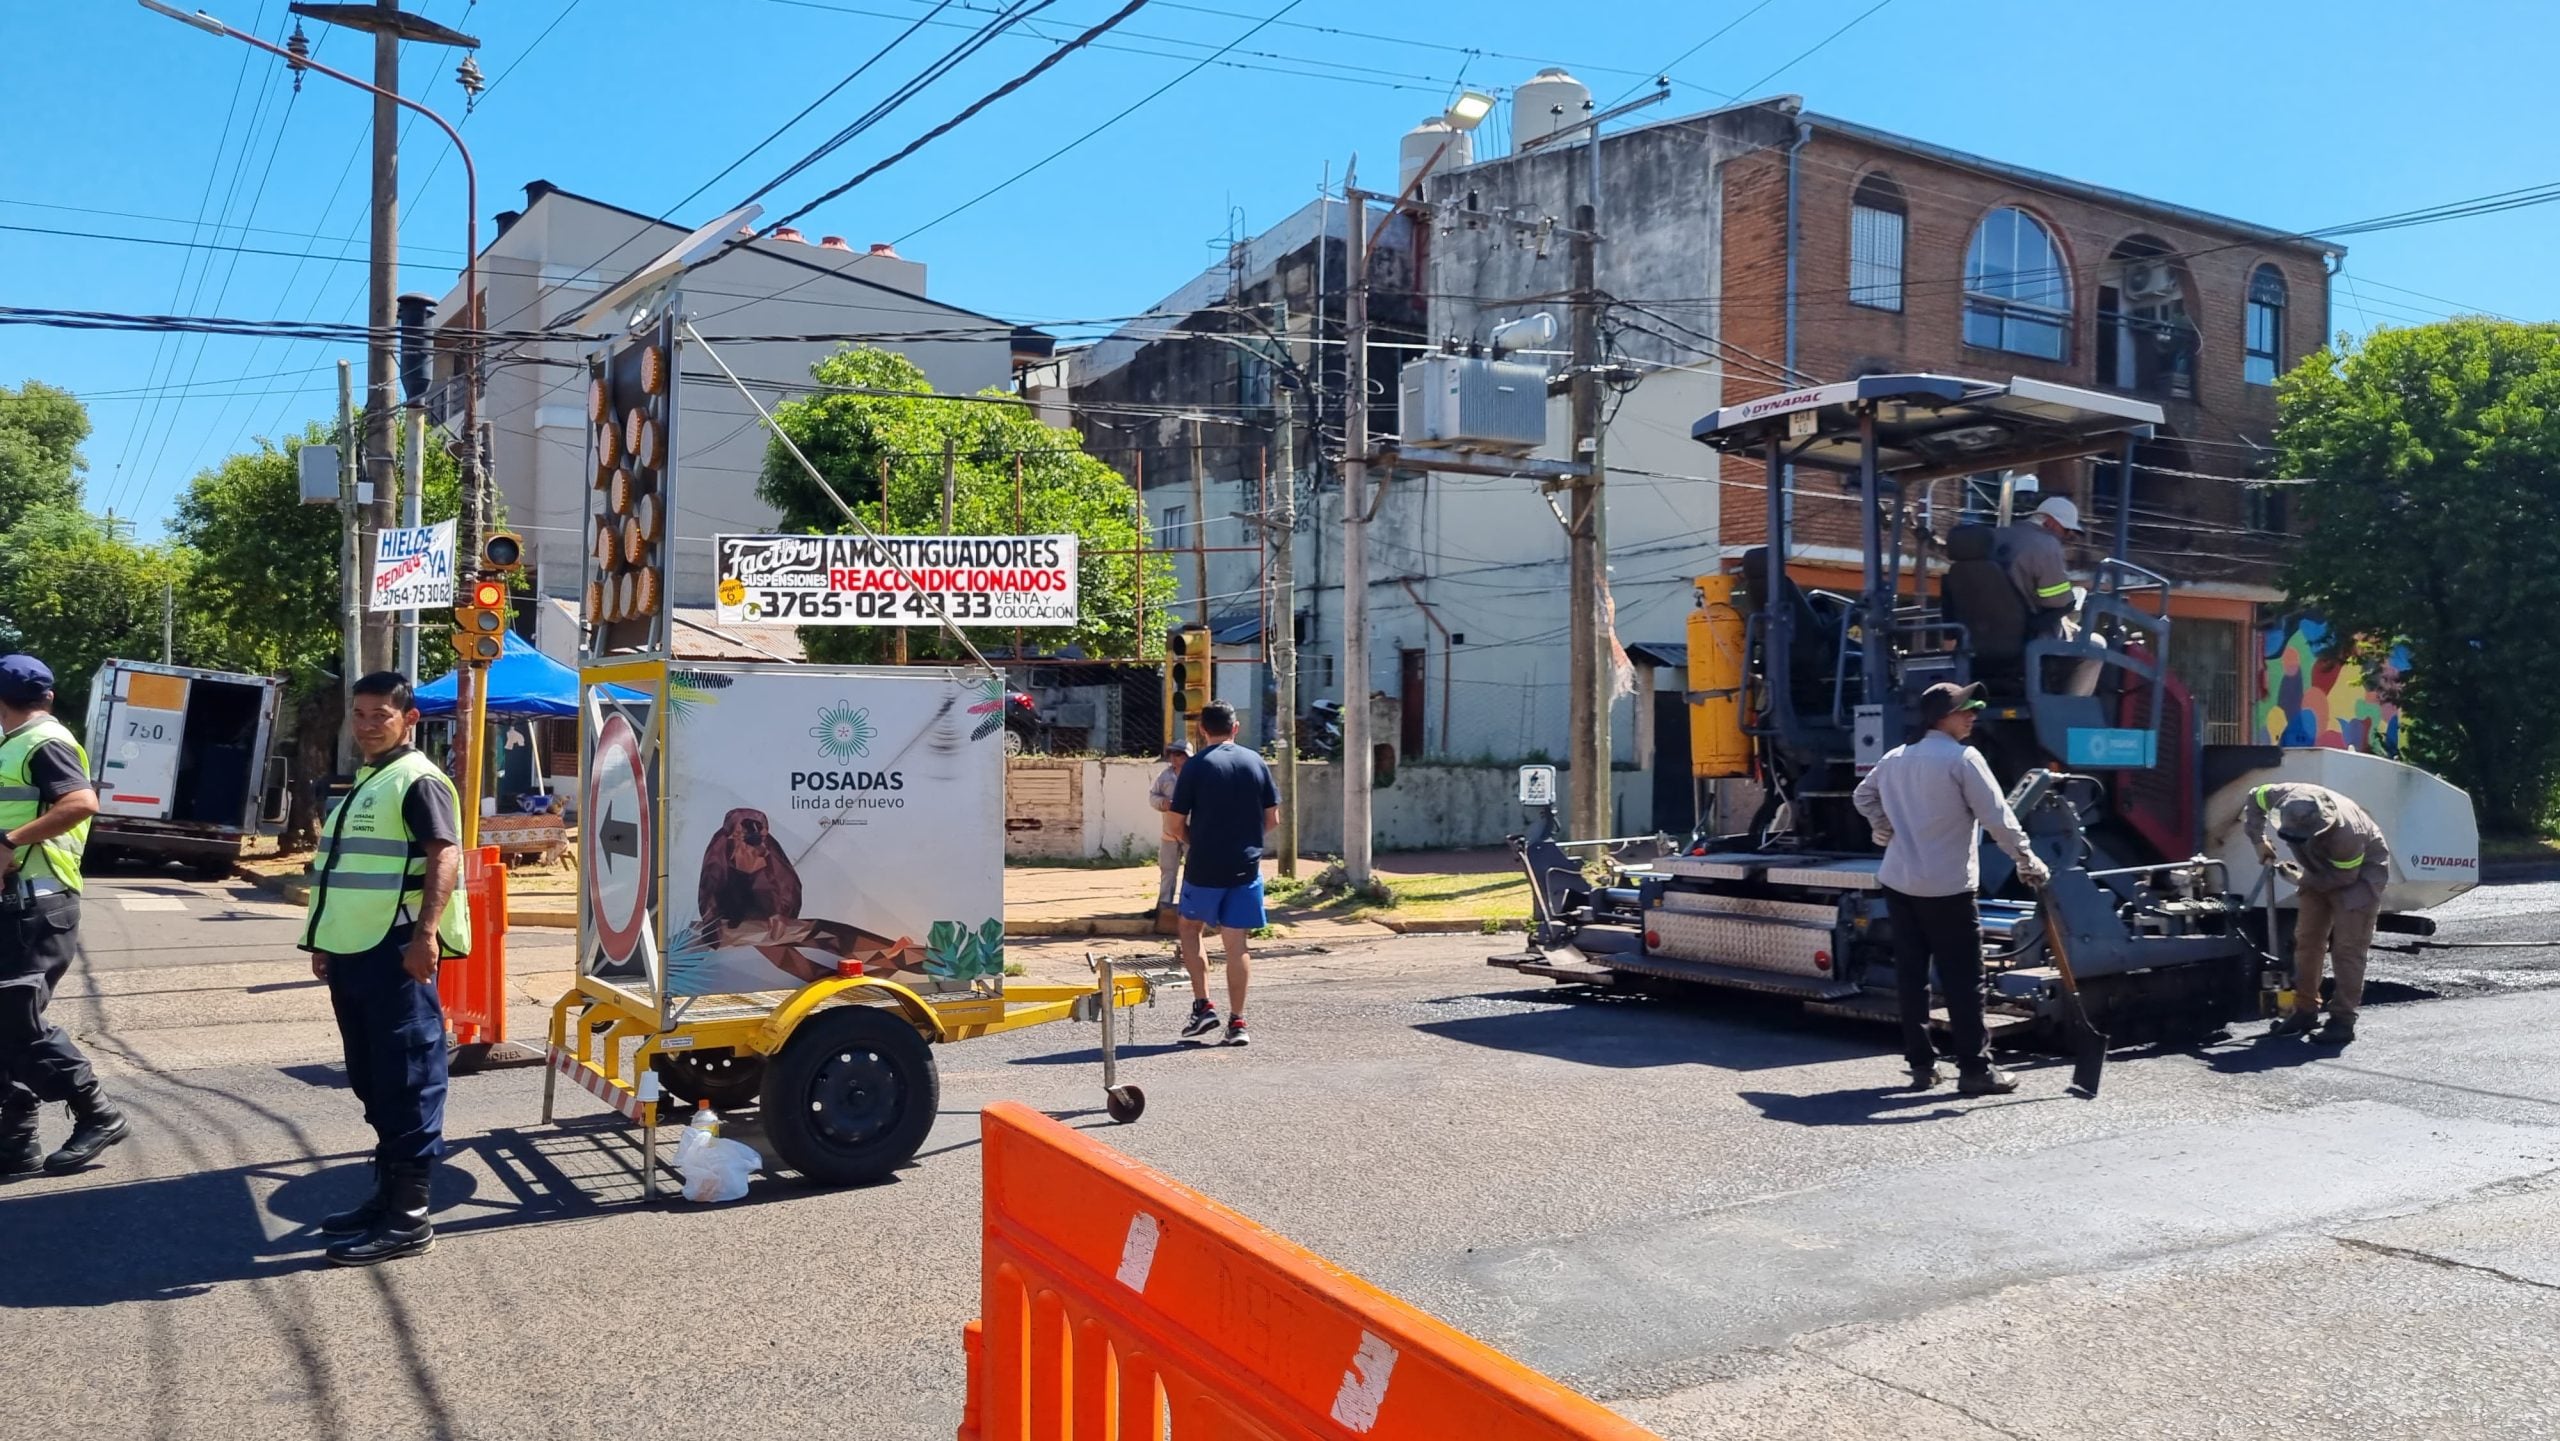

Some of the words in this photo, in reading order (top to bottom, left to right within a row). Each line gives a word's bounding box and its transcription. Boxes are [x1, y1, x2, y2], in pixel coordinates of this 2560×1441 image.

[1752, 392, 1822, 414] DYNAPAC
[382, 528, 434, 557] HIELOS
[723, 538, 822, 580] Factory
[830, 539, 1059, 567] AMORTIGUADORES
[741, 573, 827, 588] SUSPENSIONES
[830, 569, 1066, 592] REACONDICIONADOS
[995, 592, 1040, 604] VENTA
[995, 603, 1073, 618] COLOCACIÓN
[791, 771, 904, 791] POSADAS
[791, 795, 830, 809] linda
[835, 795, 854, 809] de
[858, 797, 904, 809] nuevo
[2421, 856, 2476, 868] DYNAPAC
